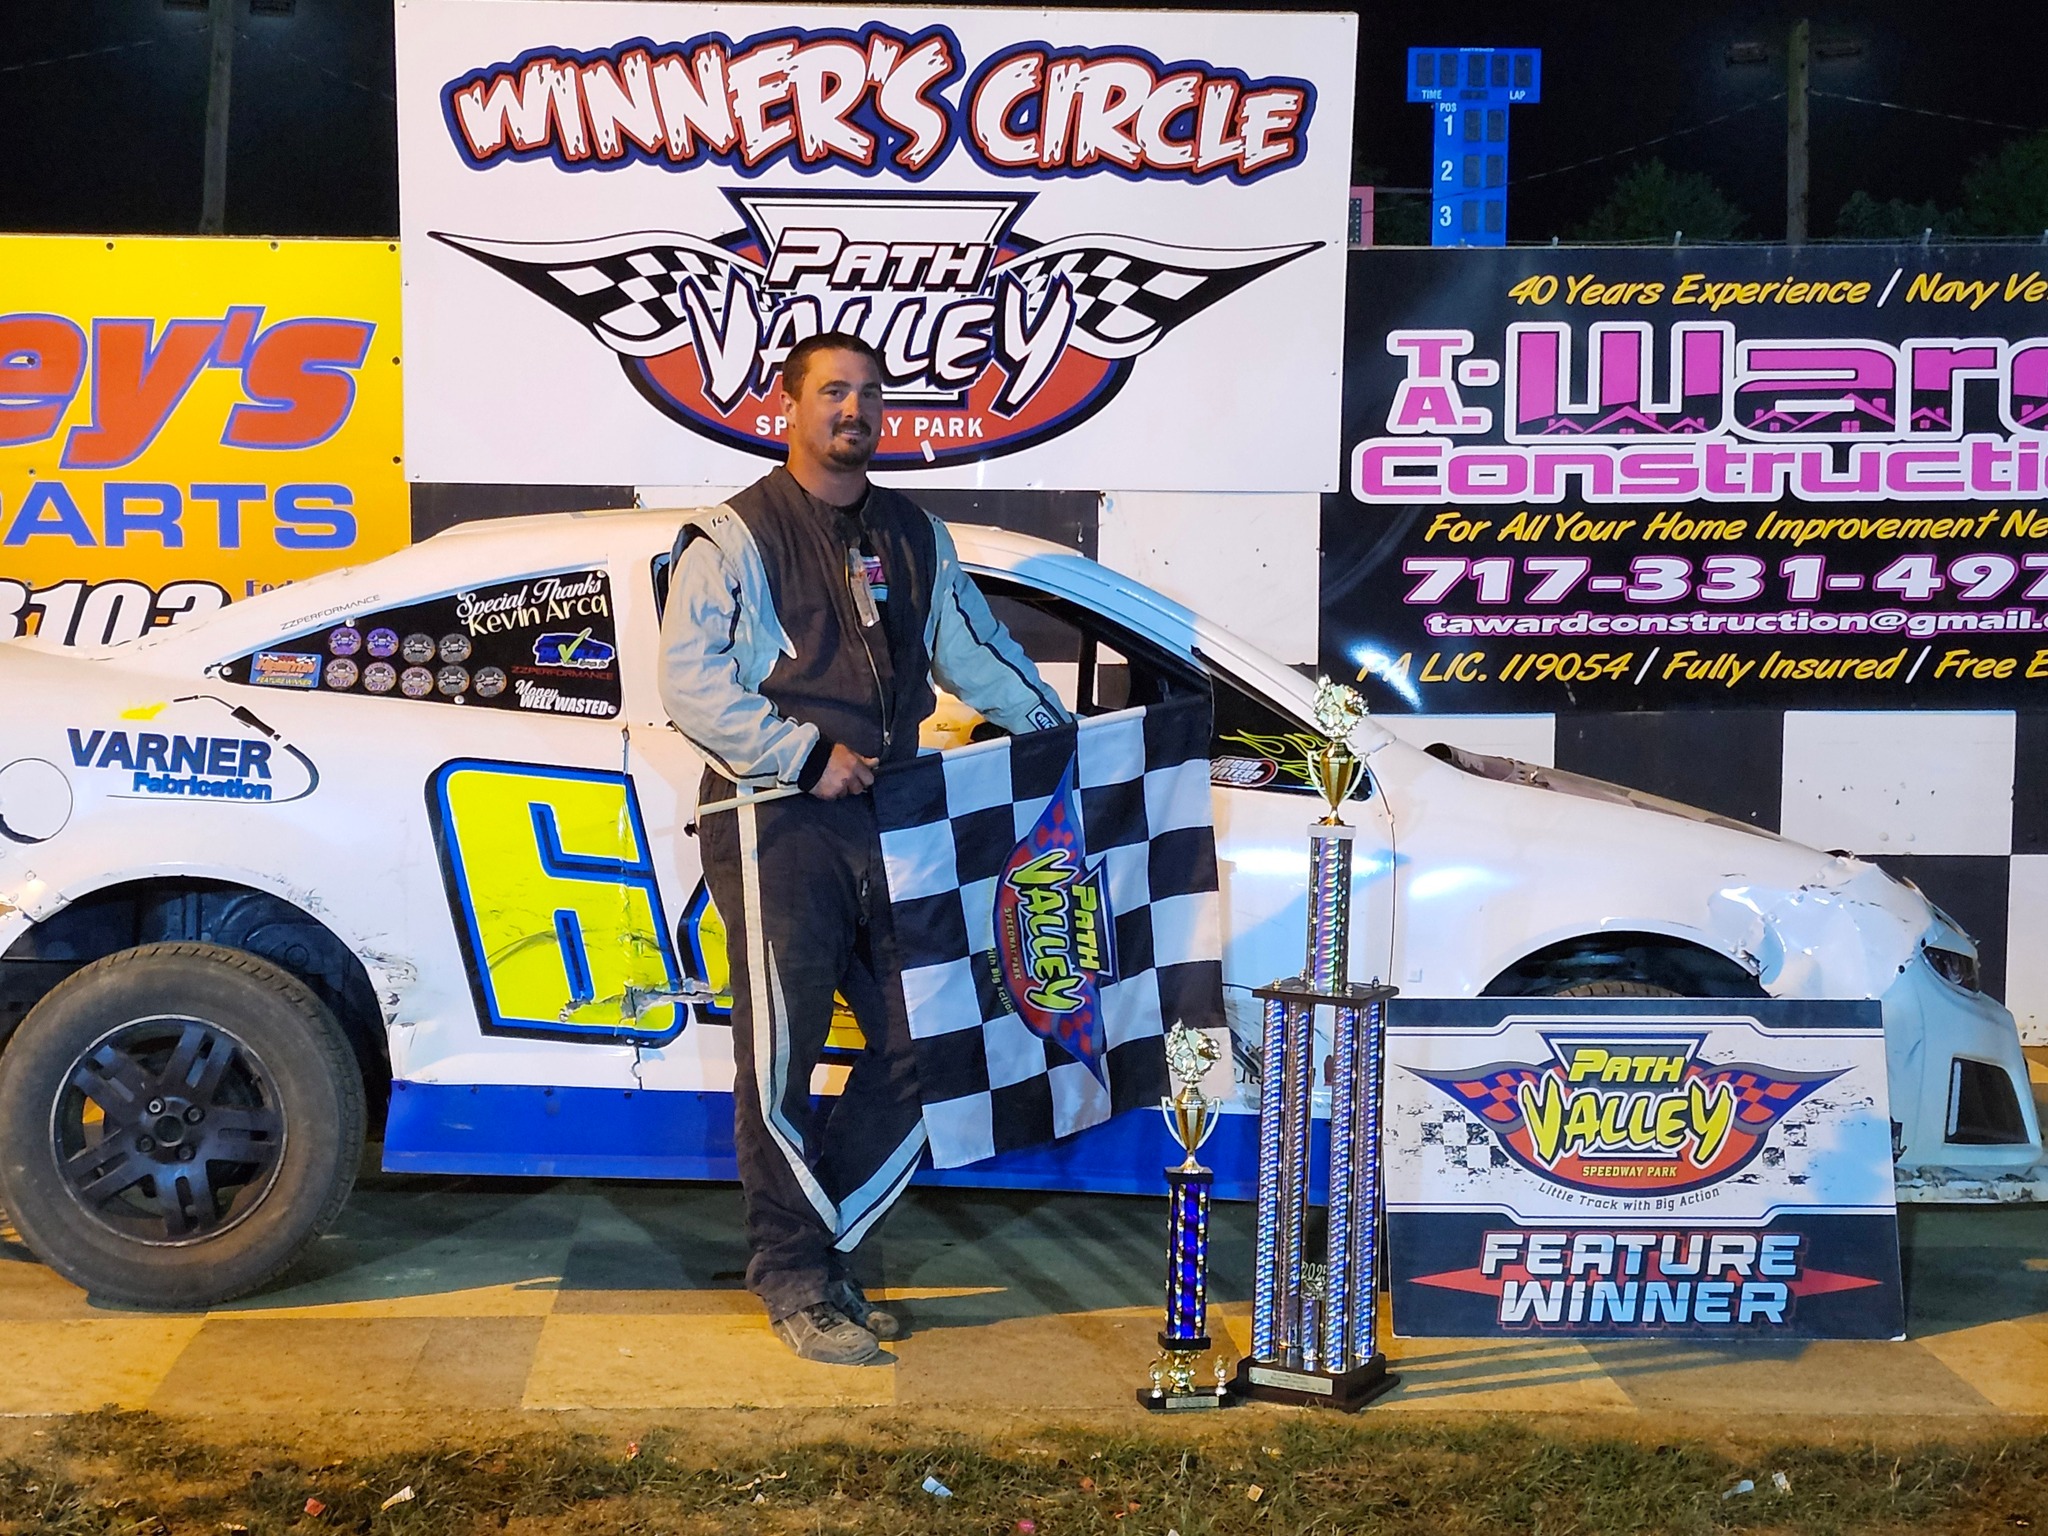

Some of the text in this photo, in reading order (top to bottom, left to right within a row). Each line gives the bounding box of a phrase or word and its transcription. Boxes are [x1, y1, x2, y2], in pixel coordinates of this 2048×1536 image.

[449, 25, 1309, 180] WINNER'S CIRCLE
[1421, 89, 1526, 100] TIME LAP
[1439, 102, 1457, 112] POS
[1443, 114, 1453, 136] 1
[1441, 160, 1453, 181] 2
[1440, 205, 1452, 226] 3
[1508, 273, 1559, 305] 40
[1565, 273, 1662, 305] Years
[1671, 273, 1871, 311] Experience
[1905, 272, 2000, 312] Navy
[2003, 271, 2048, 302] Ve
[914, 416, 984, 438] PARK
[1353, 437, 2048, 504] Constructi
[0, 481, 358, 550] ARTS
[1424, 512, 1491, 544] For
[1497, 512, 1553, 544] All
[1553, 513, 1631, 544] Your
[1642, 511, 1746, 543] Home
[1755, 508, 2000, 548] Improvement
[280, 594, 381, 631] ZZPERFORMANCE
[456, 573, 602, 625] Special Thanks
[468, 605, 541, 637] Kevin
[1426, 608, 2048, 639] tawardconstruction@gmail.
[1419, 651, 1487, 682] LIC.
[1499, 651, 1634, 682] 119054
[1661, 650, 1750, 684] Fully
[1763, 648, 1908, 682] Insured
[1933, 648, 2018, 679] Free
[515, 679, 559, 699] Money
[519, 694, 609, 716] WELL WASTED
[66, 727, 274, 780] VARNER
[132, 771, 273, 801] Fabrication
[424, 757, 735, 1050] 6
[1007, 850, 1085, 1013] VALLEY
[1011, 956, 1023, 980] PARK
[1521, 1076, 1734, 1164] VALLEY
[1582, 1166, 1678, 1178] SPEEDWAY PARK
[1538, 1182, 1720, 1212] Little Track with Big Action
[1479, 1233, 1801, 1276] FEATURE
[1498, 1280, 1790, 1324] WINNER
